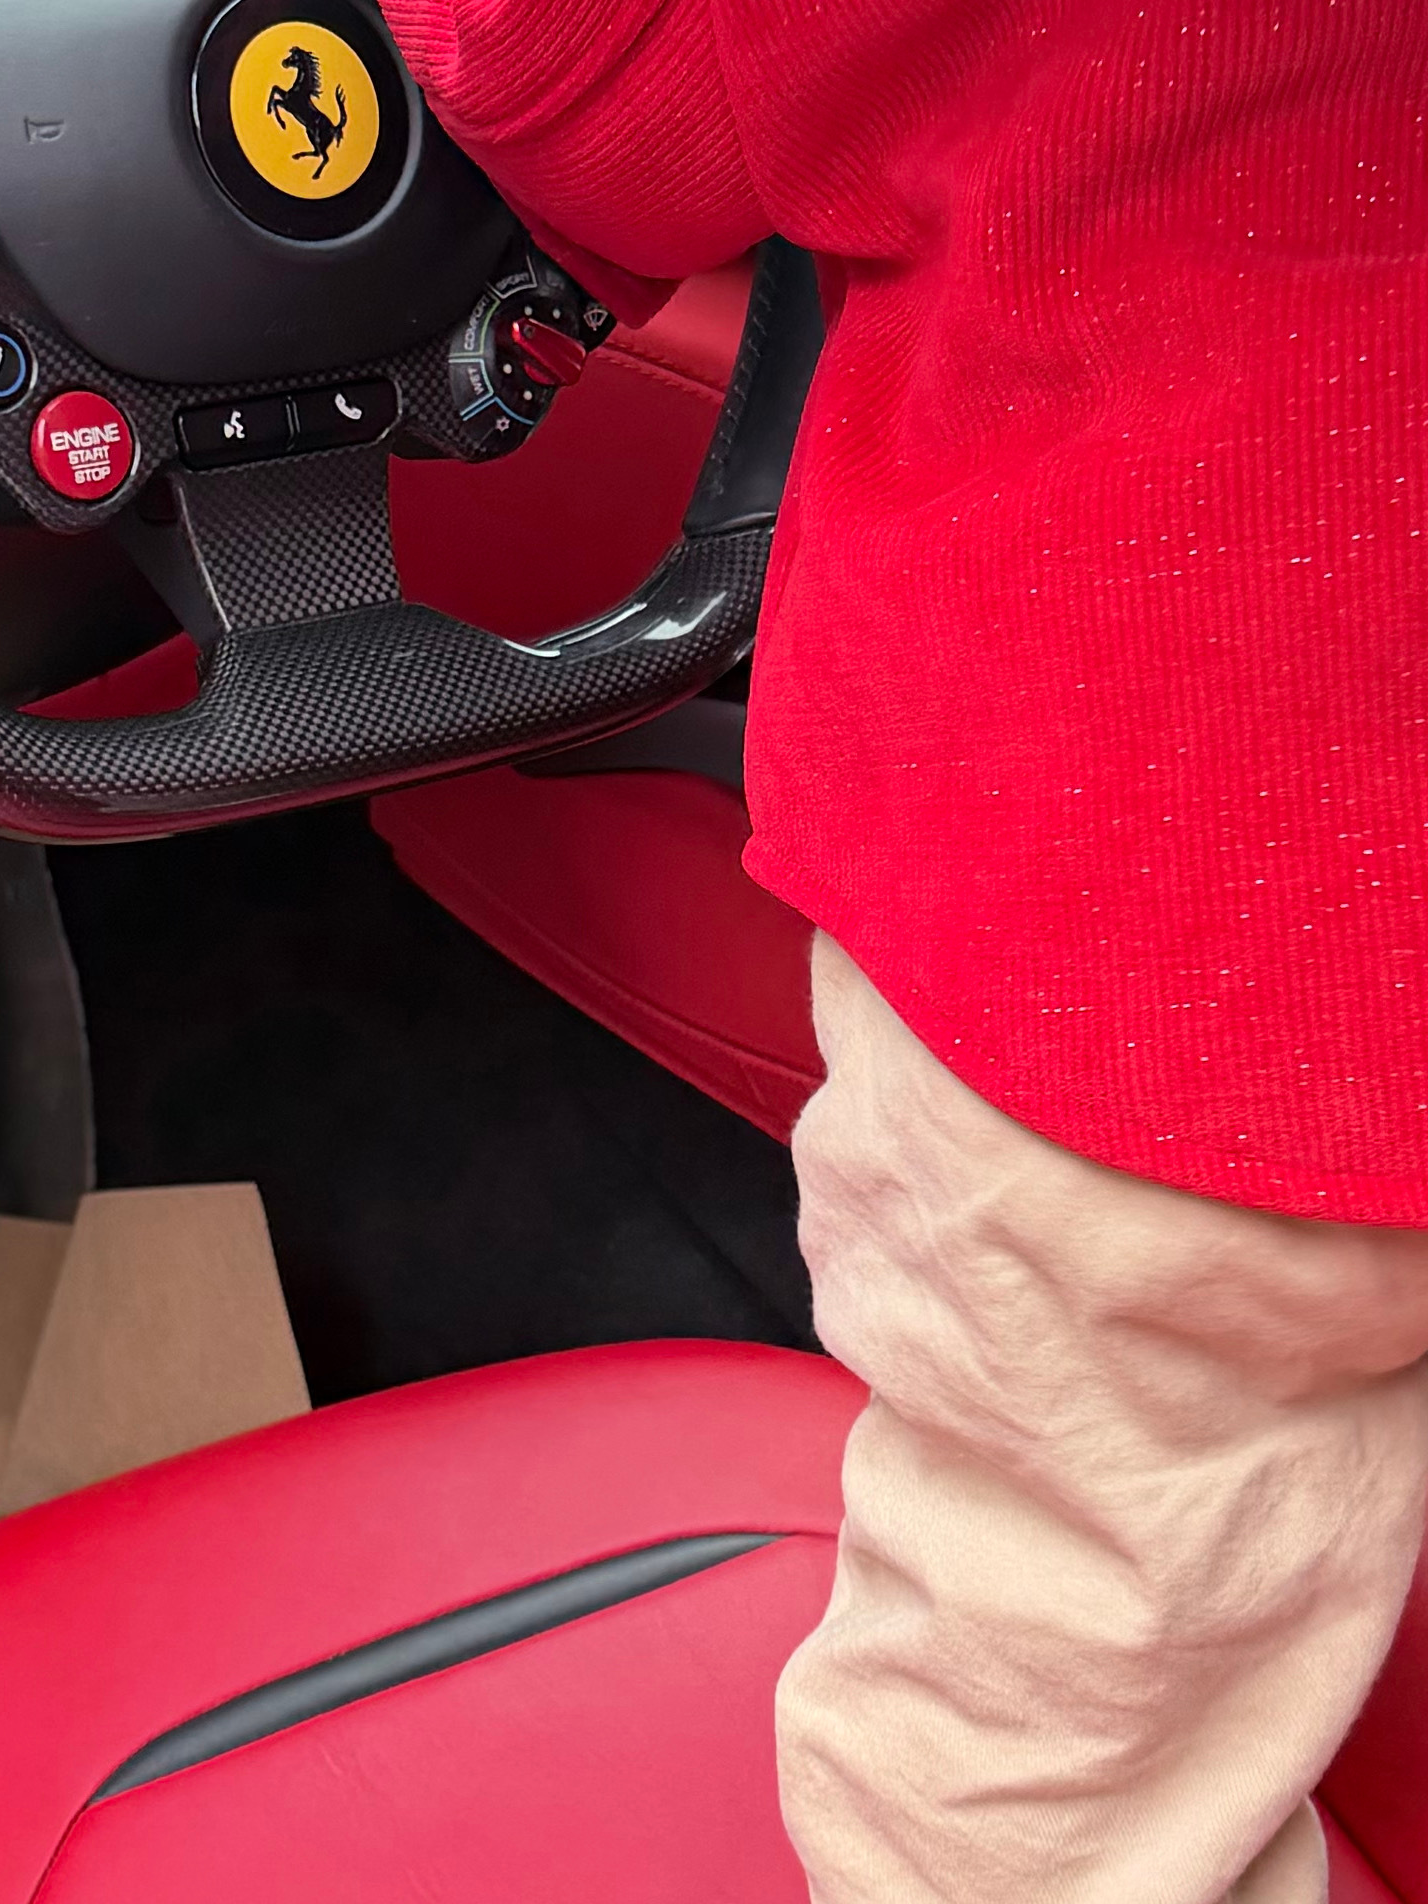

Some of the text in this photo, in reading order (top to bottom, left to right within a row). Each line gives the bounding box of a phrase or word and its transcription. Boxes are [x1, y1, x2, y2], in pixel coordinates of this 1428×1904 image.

[49, 422, 121, 451] ENGINE
[68, 445, 110, 465] START
[74, 465, 111, 484] STOP
